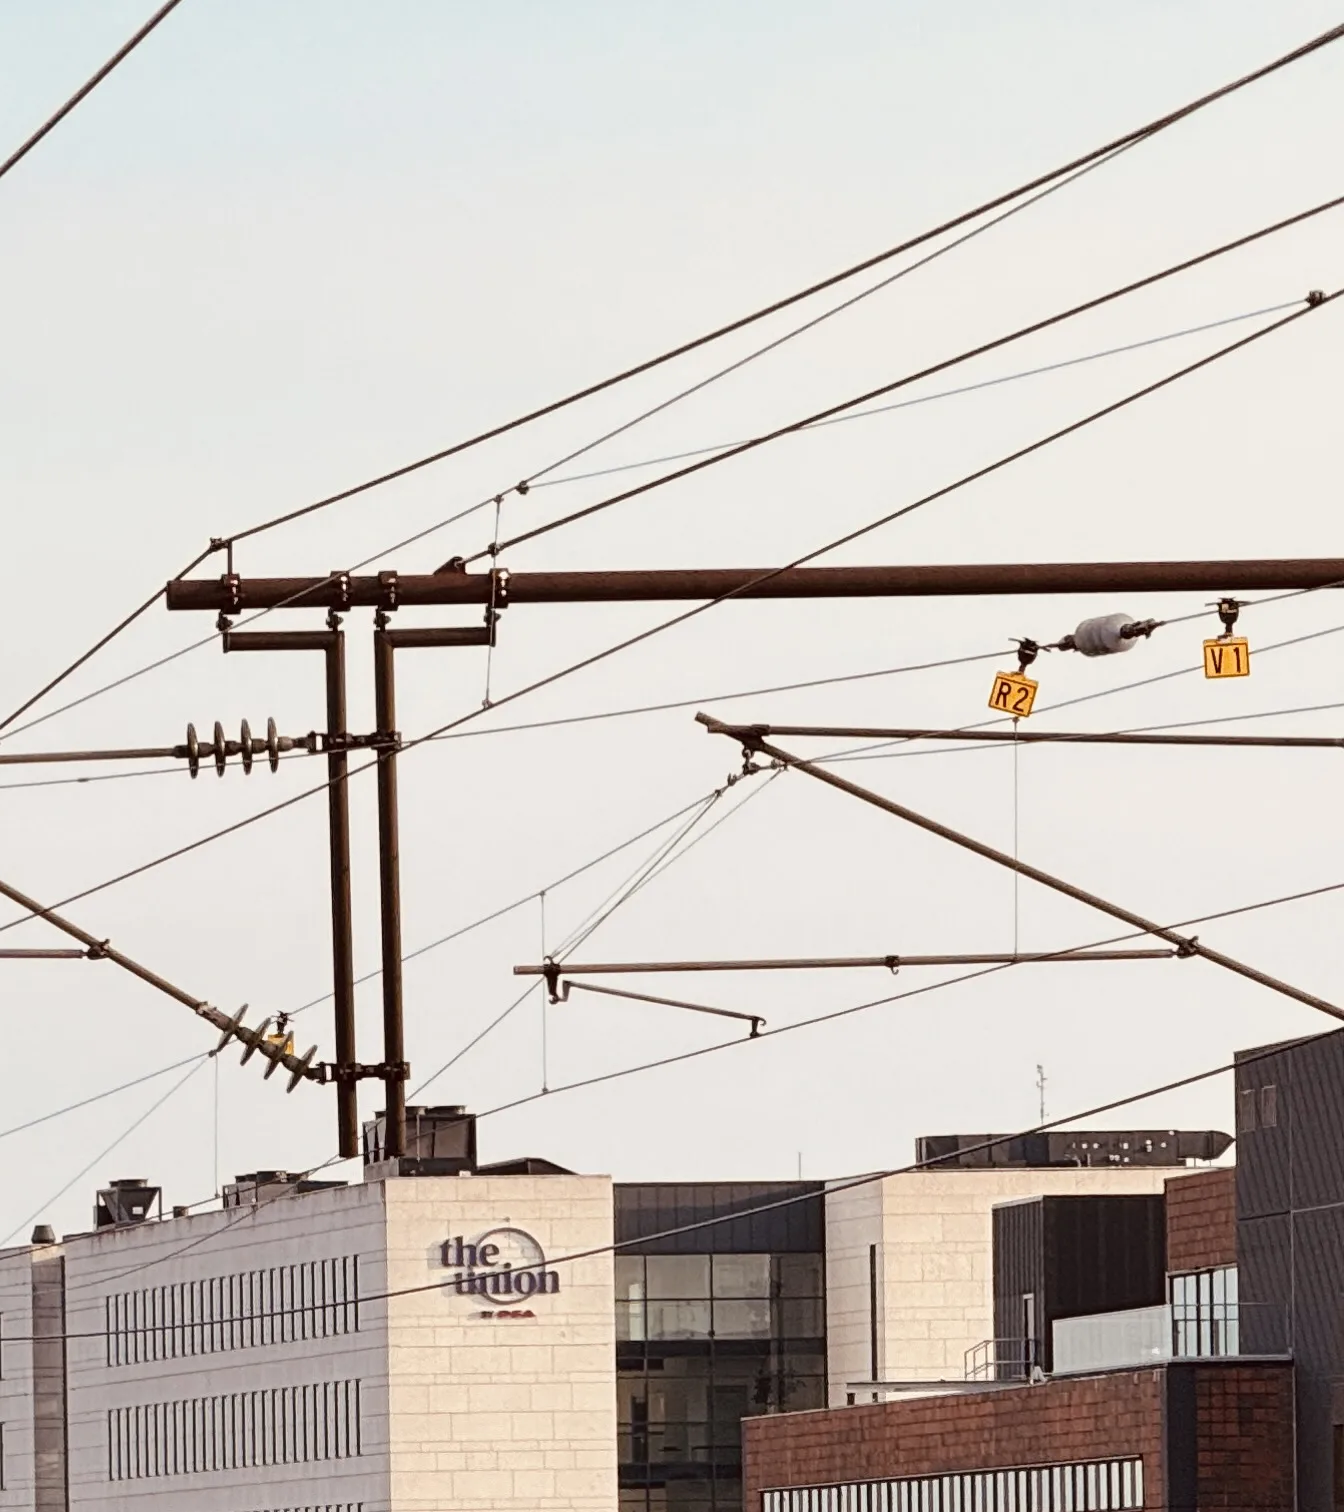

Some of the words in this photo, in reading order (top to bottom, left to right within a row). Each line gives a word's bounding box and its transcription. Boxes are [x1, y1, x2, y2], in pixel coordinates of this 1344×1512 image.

[1210, 646, 1241, 674] V1
[995, 681, 1029, 713] R2
[440, 1235, 500, 1268] the
[454, 1262, 560, 1295] union
